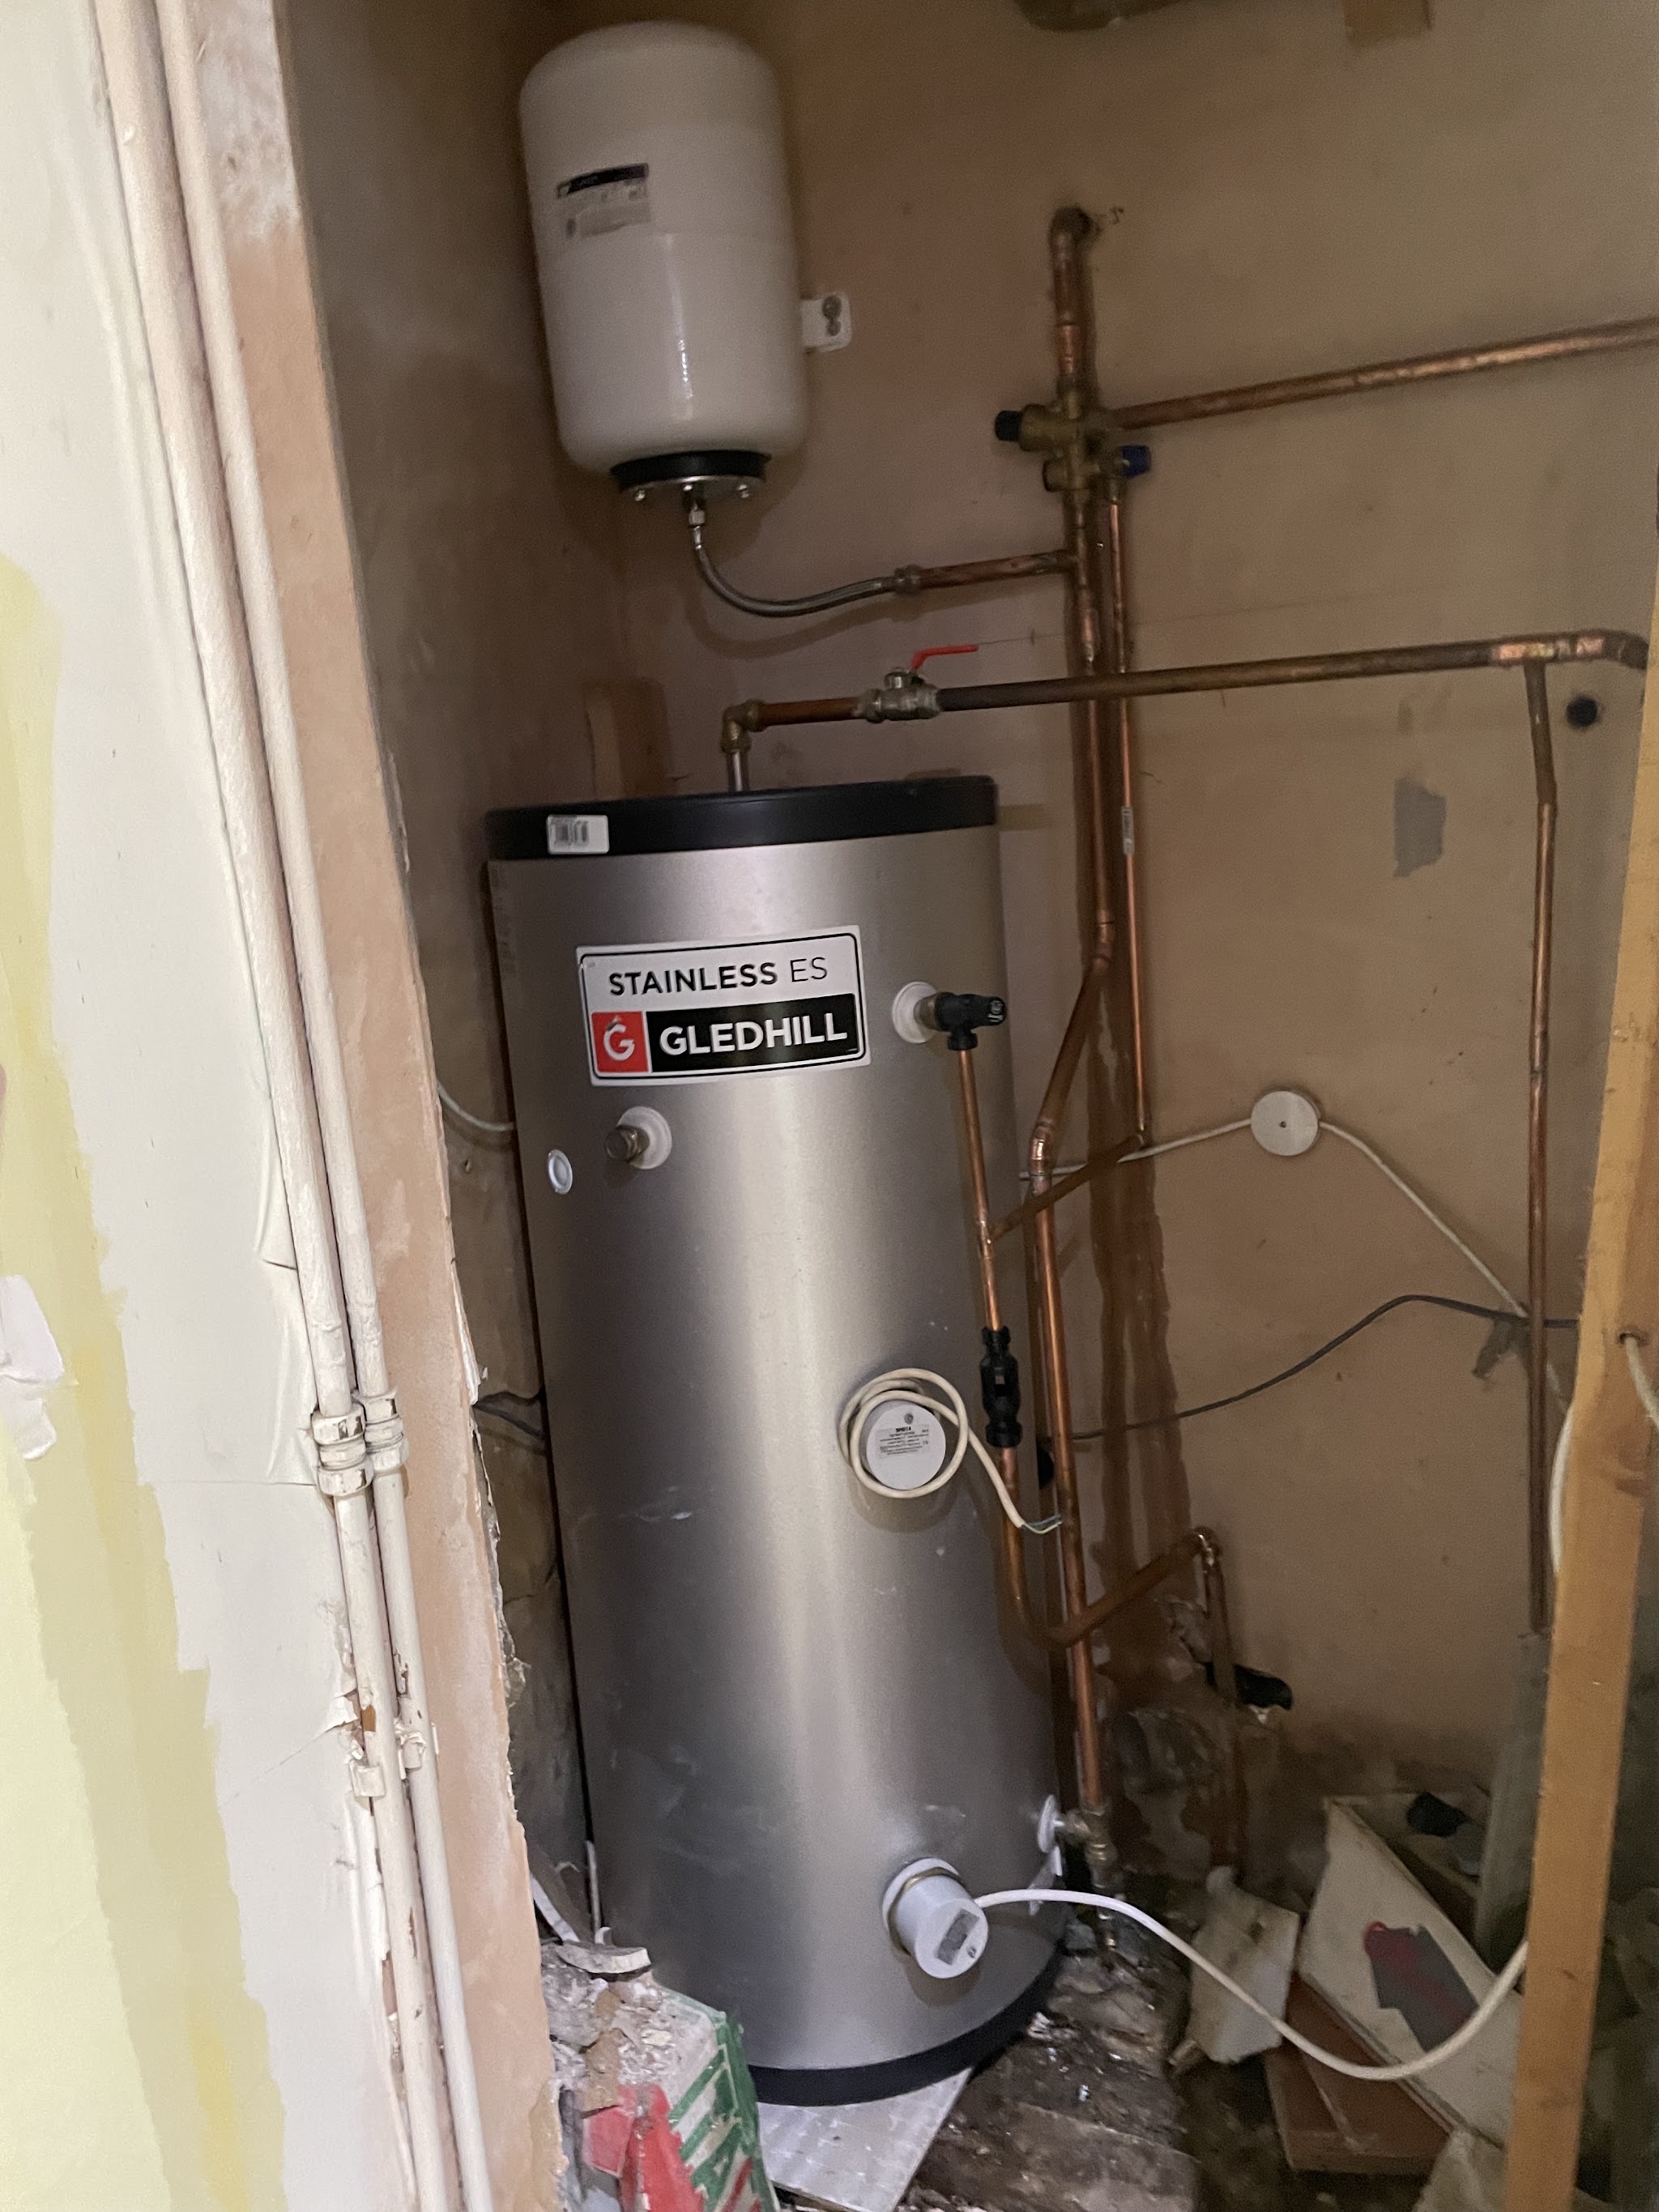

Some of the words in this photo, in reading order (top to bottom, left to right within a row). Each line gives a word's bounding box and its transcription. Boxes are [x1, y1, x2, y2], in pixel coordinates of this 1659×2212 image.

[609, 961, 778, 996] STAINLESS
[791, 957, 828, 982] ES
[659, 1012, 847, 1055] GLEDHILL
